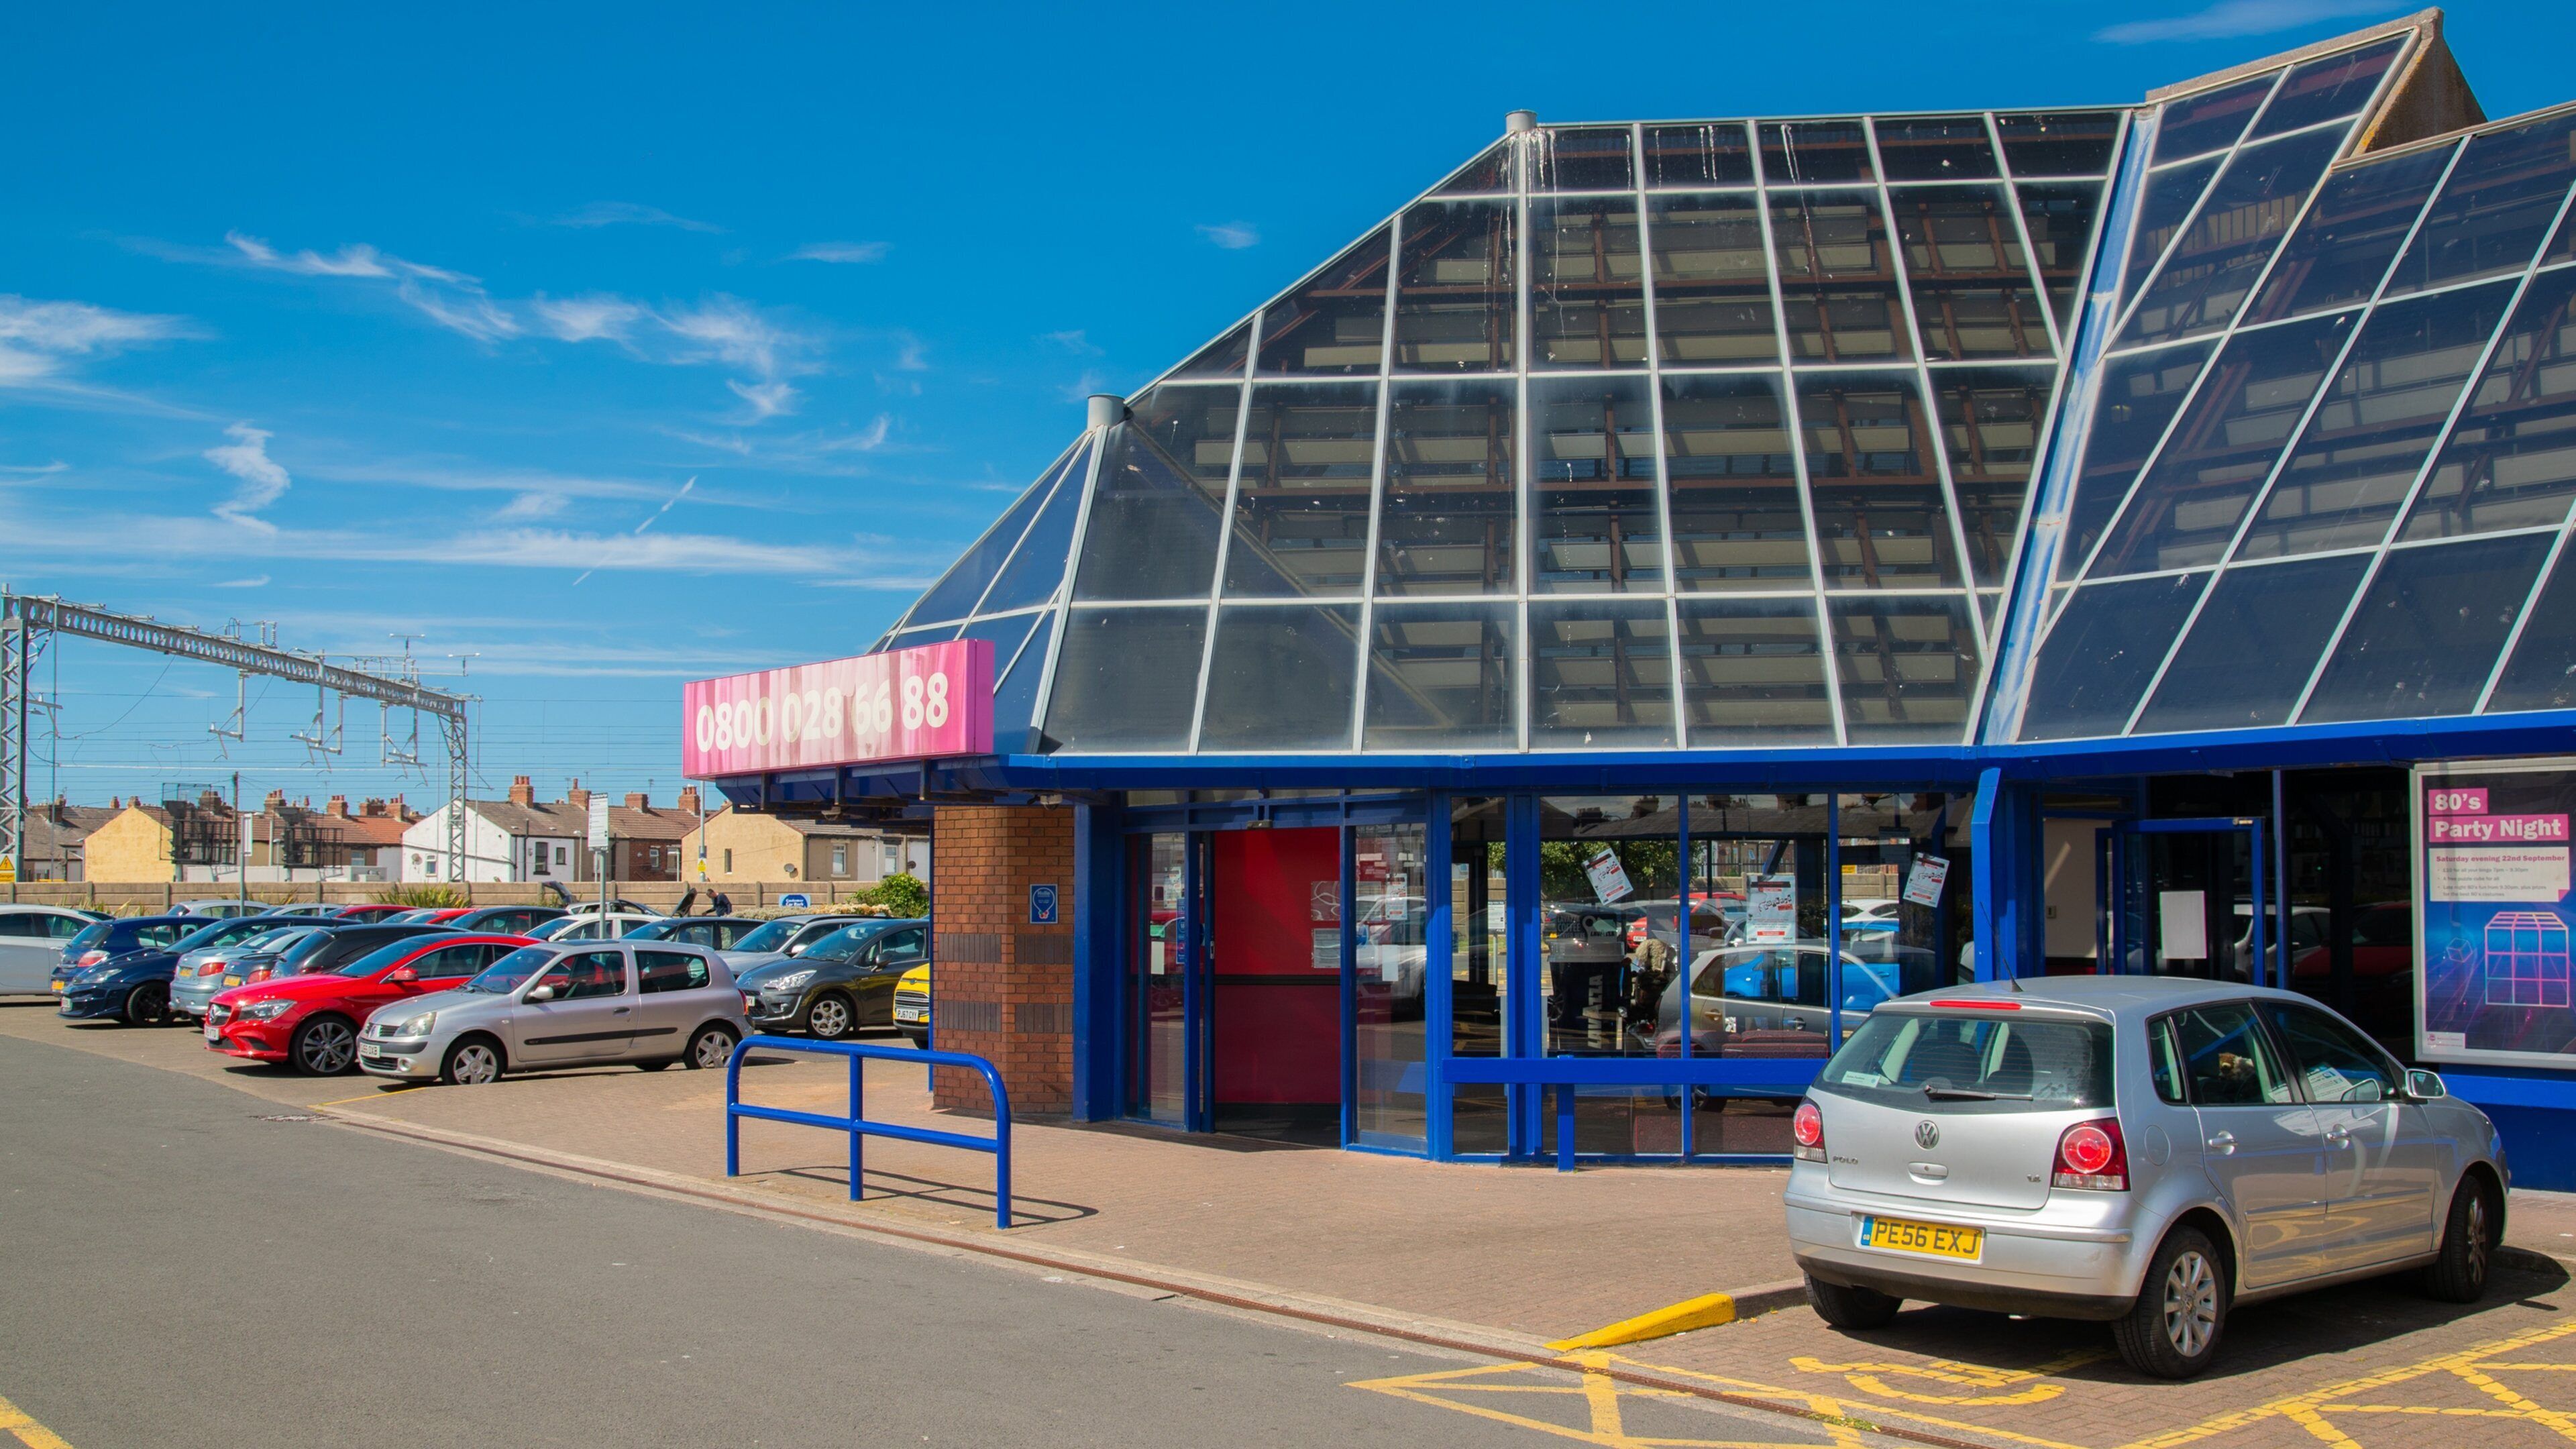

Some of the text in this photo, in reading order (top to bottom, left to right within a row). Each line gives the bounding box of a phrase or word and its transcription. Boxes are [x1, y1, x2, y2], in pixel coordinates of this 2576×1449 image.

[696, 672, 949, 753] 0800 028 66 88
[2434, 794, 2481, 810] 80's
[2434, 819, 2561, 841] Party Night
[1582, 975, 1603, 1049] LAVAZZA
[1833, 1156, 1858, 1165] POLO
[1874, 1222, 1979, 1254] PE56 EXJ
